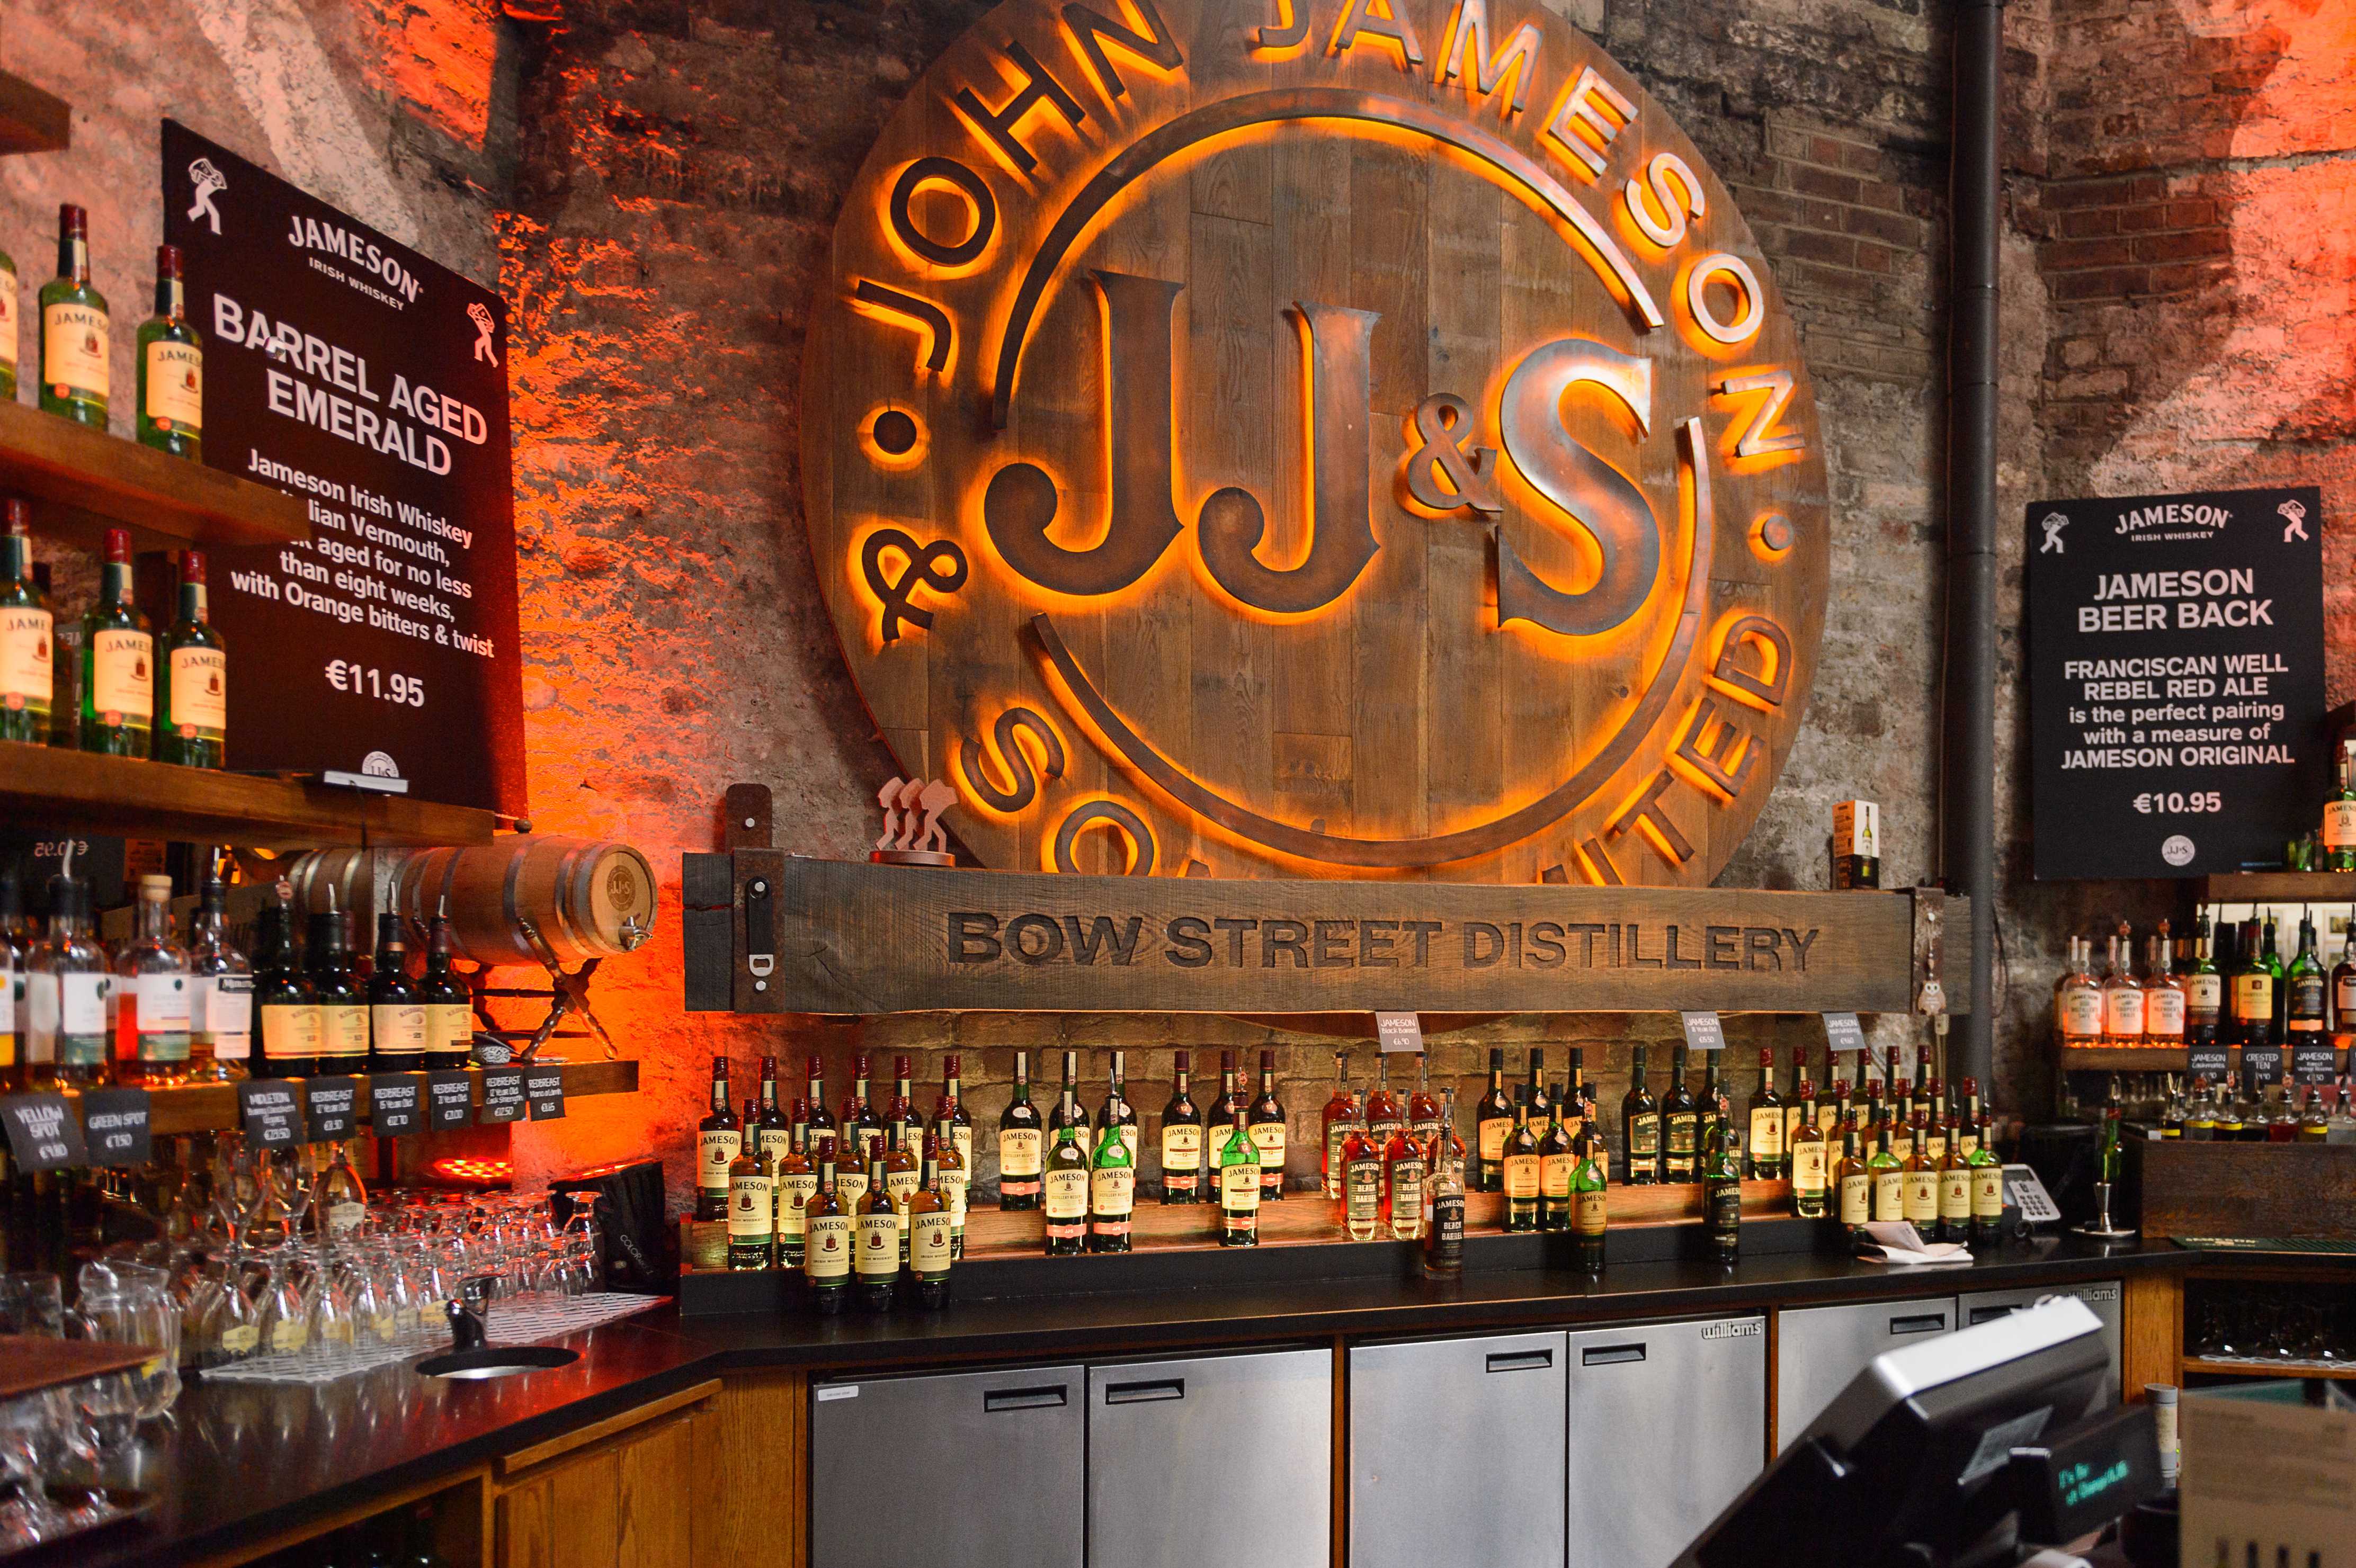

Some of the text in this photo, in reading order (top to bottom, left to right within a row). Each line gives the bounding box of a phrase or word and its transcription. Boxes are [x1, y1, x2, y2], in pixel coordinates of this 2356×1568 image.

[855, 0, 1806, 458] JOHN JAMESON
[288, 216, 420, 303] JAMESON
[309, 257, 404, 311] IRISH WHISKEY
[54, 312, 108, 329] JAMES
[157, 350, 203, 368] JAMES
[213, 293, 488, 445] BARREL AGED
[267, 369, 452, 476] EMERALD
[248, 449, 472, 549] Jameson Irish Whiskey
[2114, 504, 2229, 535] JAMESON
[350, 513, 450, 568] Vermouth,
[2131, 531, 2215, 543] IRISH WHISKEY
[318, 537, 472, 599] aged for no less
[280, 551, 456, 623] than eight weeks,
[861, 528, 970, 642] &
[2093, 568, 2253, 601] JAMESON
[230, 570, 495, 658] with Orange bitters & twist
[2078, 599, 2274, 633] BEER BACK
[2064, 653, 2289, 680] FRANCISCAN WELL
[325, 659, 425, 707] €11.95
[2084, 676, 2269, 702] REBEL RED ALE
[2069, 701, 2284, 725] is the perfect pairing
[2083, 722, 2271, 745] with a measure of
[2060, 745, 2296, 770] JAMESON ORIGINAL
[960, 706, 1212, 877] SO
[2132, 792, 2222, 813] €10.95
[949, 912, 1819, 972] BOW STREET DISTILLERY
[1380, 1019, 1416, 1027] JAMESON
[1686, 1017, 1718, 1026] JAMESON
[2191, 1053, 2226, 1062] JAMESON
[2245, 1053, 2278, 1062] CRESTED
[2297, 1052, 2333, 1061] JAMESON
[486, 1076, 521, 1087] REDBREAST
[528, 1077, 561, 1089] REDBREAST
[14, 1105, 65, 1124] YELLOW
[88, 1114, 122, 1129] GREEN
[1167, 1128, 1200, 1137] JAMESON
[1253, 1126, 1285, 1135] JAMESON
[1413, 1122, 1440, 1132] JAMESO
[1487, 1121, 1513, 1130] JAMES
[700, 1135, 739, 1146] JAMESON
[1003, 1132, 1038, 1142] JAMESON
[1350, 1162, 1379, 1172] JAMESON
[1395, 1162, 1423, 1172] JAMESON
[1547, 1157, 1574, 1166] JAMESO
[1049, 1173, 1086, 1184] JAMESON
[1097, 1171, 1131, 1181] JAMESON
[1228, 1167, 1261, 1177] JAMESON
[729, 1181, 769, 1192] JAMESON
[889, 1176, 918, 1187] AMESO
[1436, 1199, 1465, 1209] JAMESON
[808, 1221, 849, 1234] JAMESON
[856, 1219, 898, 1231] JAMESON
[1443, 1221, 1462, 1230] BLACK
[1441, 1232, 1462, 1240] BARREL
[2068, 1288, 2117, 1302] illiams
[1701, 1321, 1762, 1340] williams
